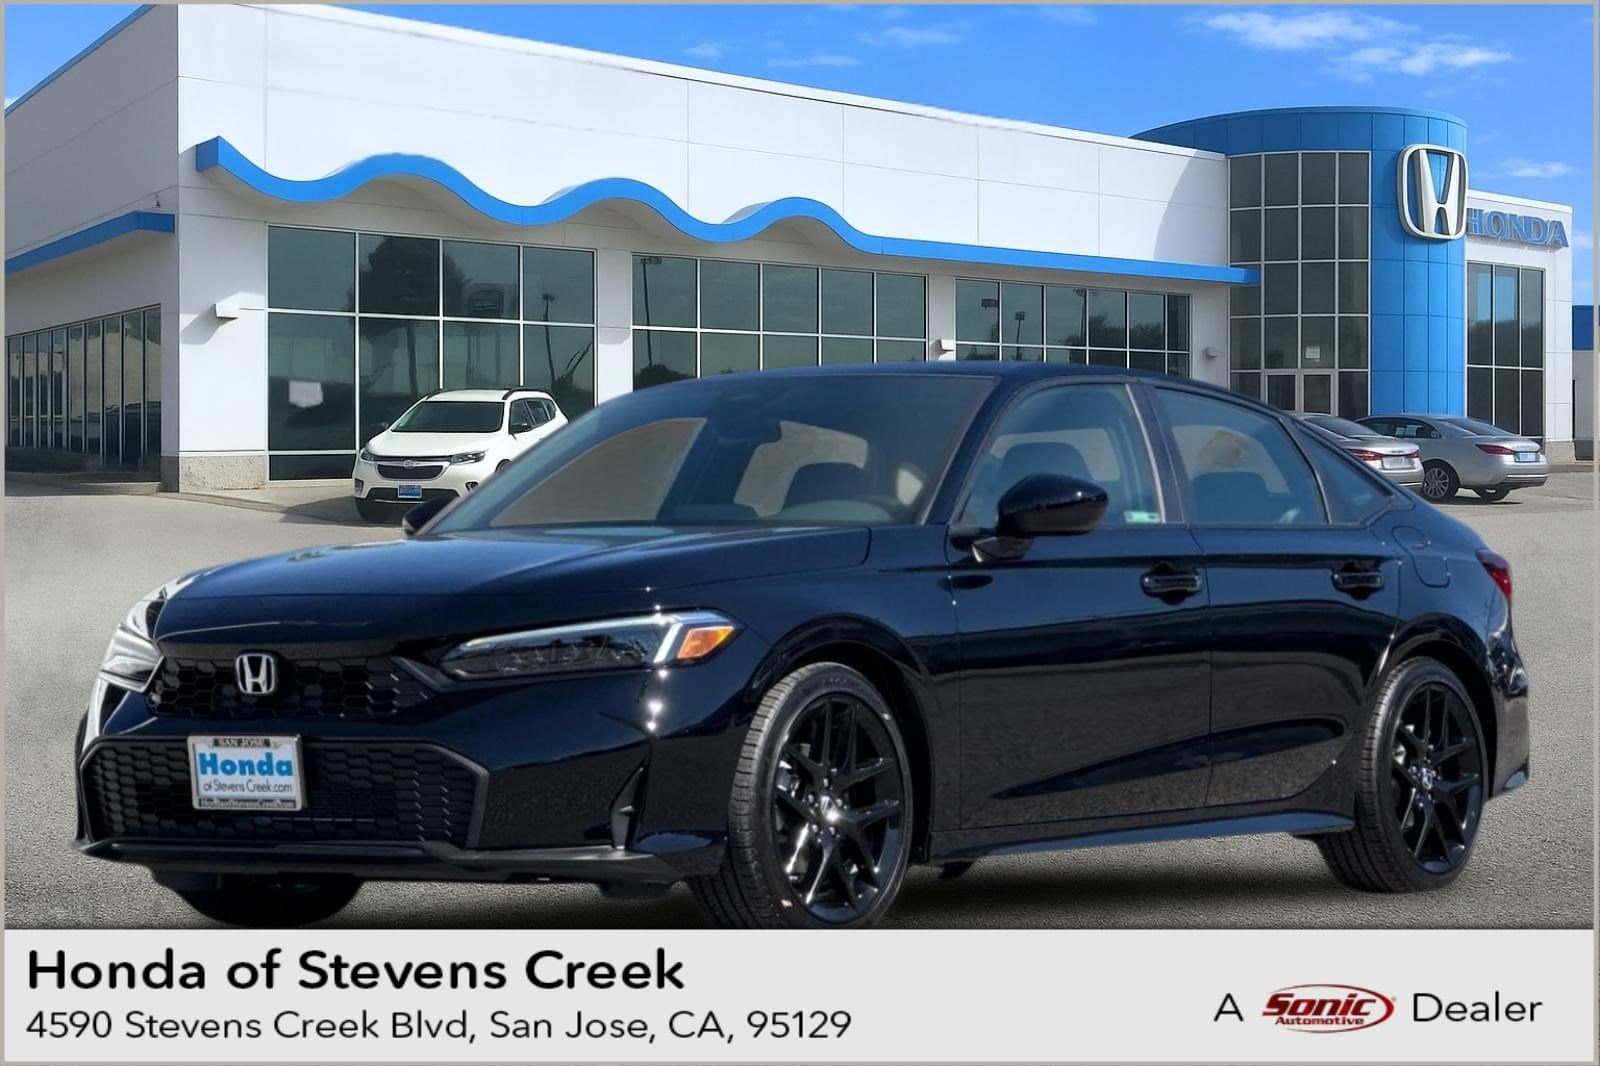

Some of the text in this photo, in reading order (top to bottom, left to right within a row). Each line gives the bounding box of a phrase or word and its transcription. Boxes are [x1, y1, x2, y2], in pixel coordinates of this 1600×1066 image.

[1466, 208, 1569, 248] HONDA
[198, 752, 293, 776] Honda
[203, 782, 212, 792] of
